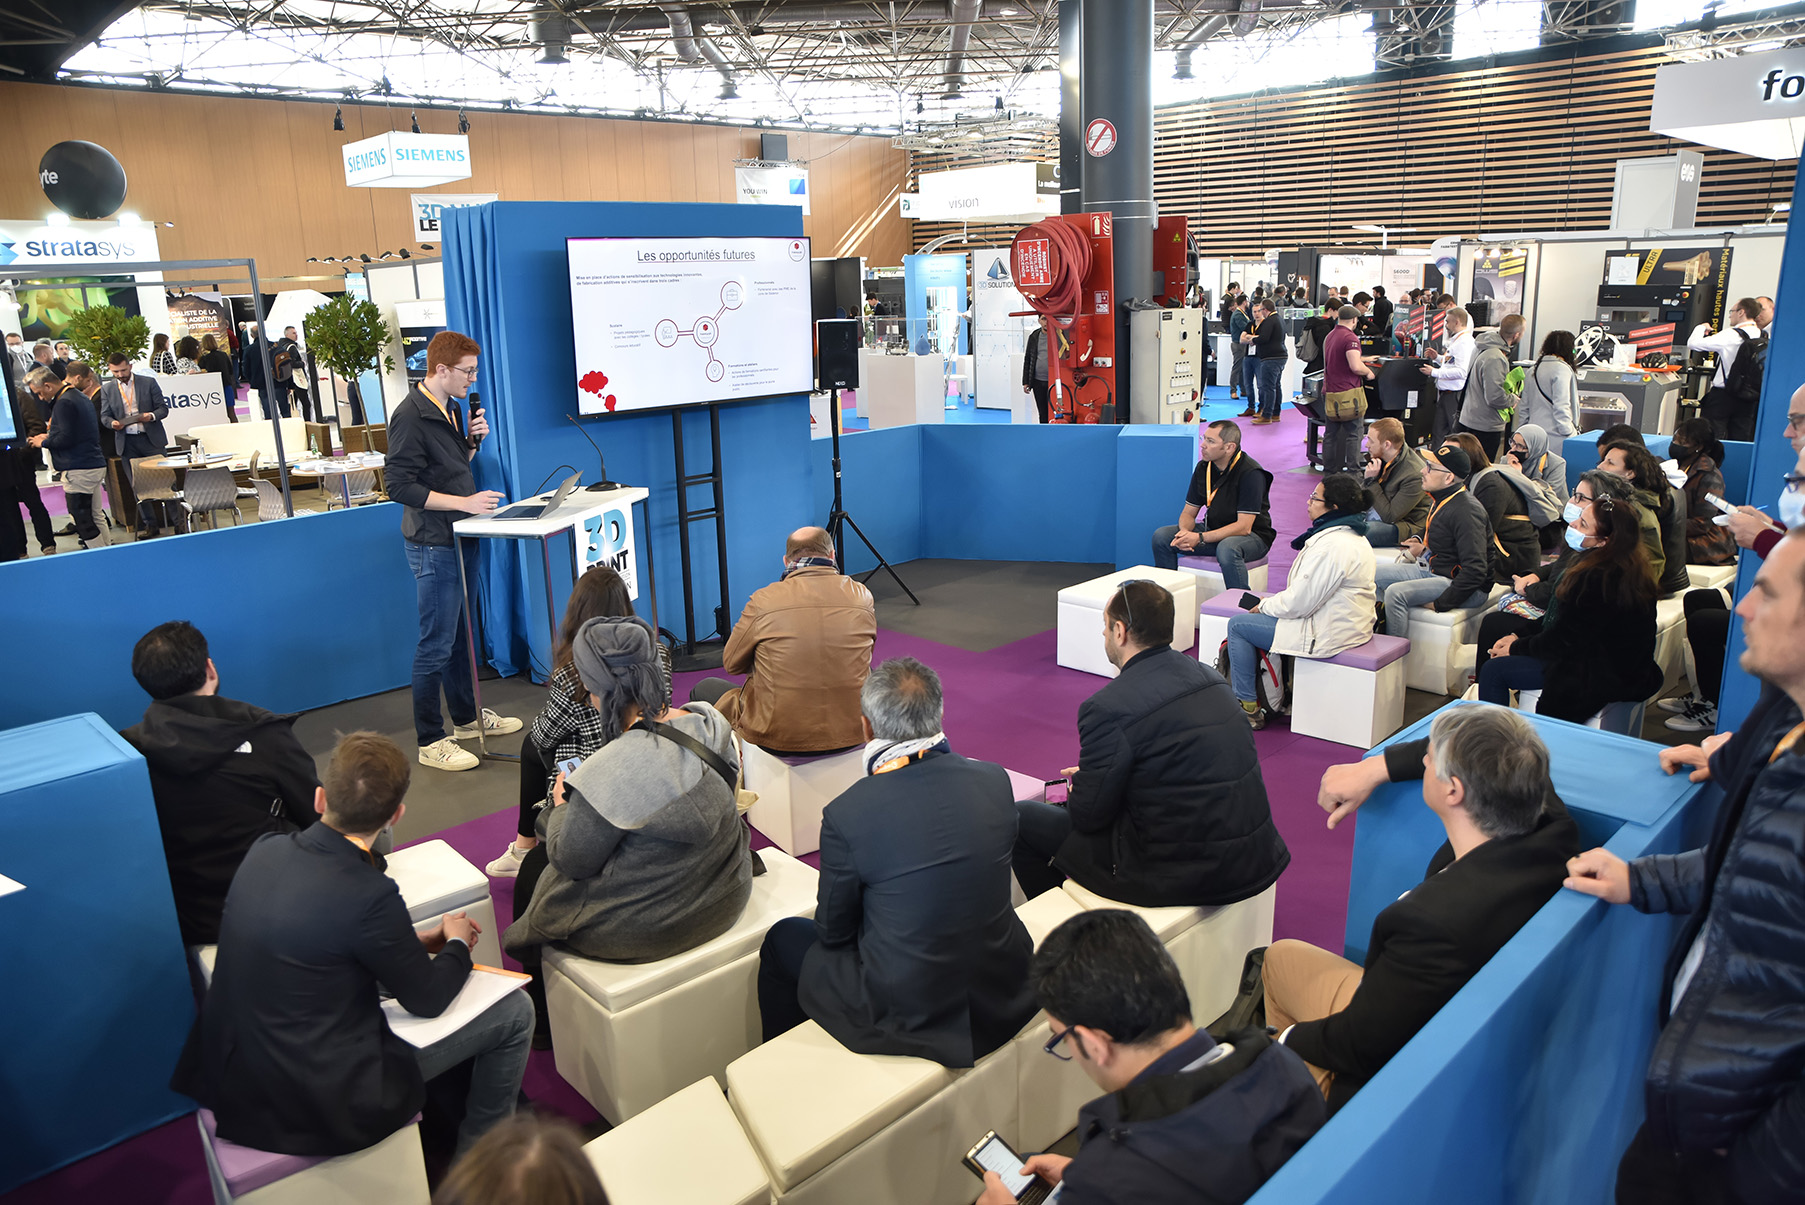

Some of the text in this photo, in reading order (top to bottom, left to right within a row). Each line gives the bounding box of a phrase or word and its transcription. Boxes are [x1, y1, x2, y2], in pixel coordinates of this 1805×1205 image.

[348, 148, 386, 172] SIEMENS
[396, 148, 465, 162] SIEMENS
[948, 196, 979, 208] vision
[418, 204, 441, 221] 3D
[420, 219, 438, 231] LE
[26, 240, 135, 259] stratasys
[637, 249, 755, 262] Les opportunités futures
[1643, 251, 1658, 273] ULTRA
[1717, 248, 1730, 288] Matériaux
[1714, 290, 1724, 315] hautes
[163, 392, 221, 409] atasys
[584, 509, 626, 562] 3D
